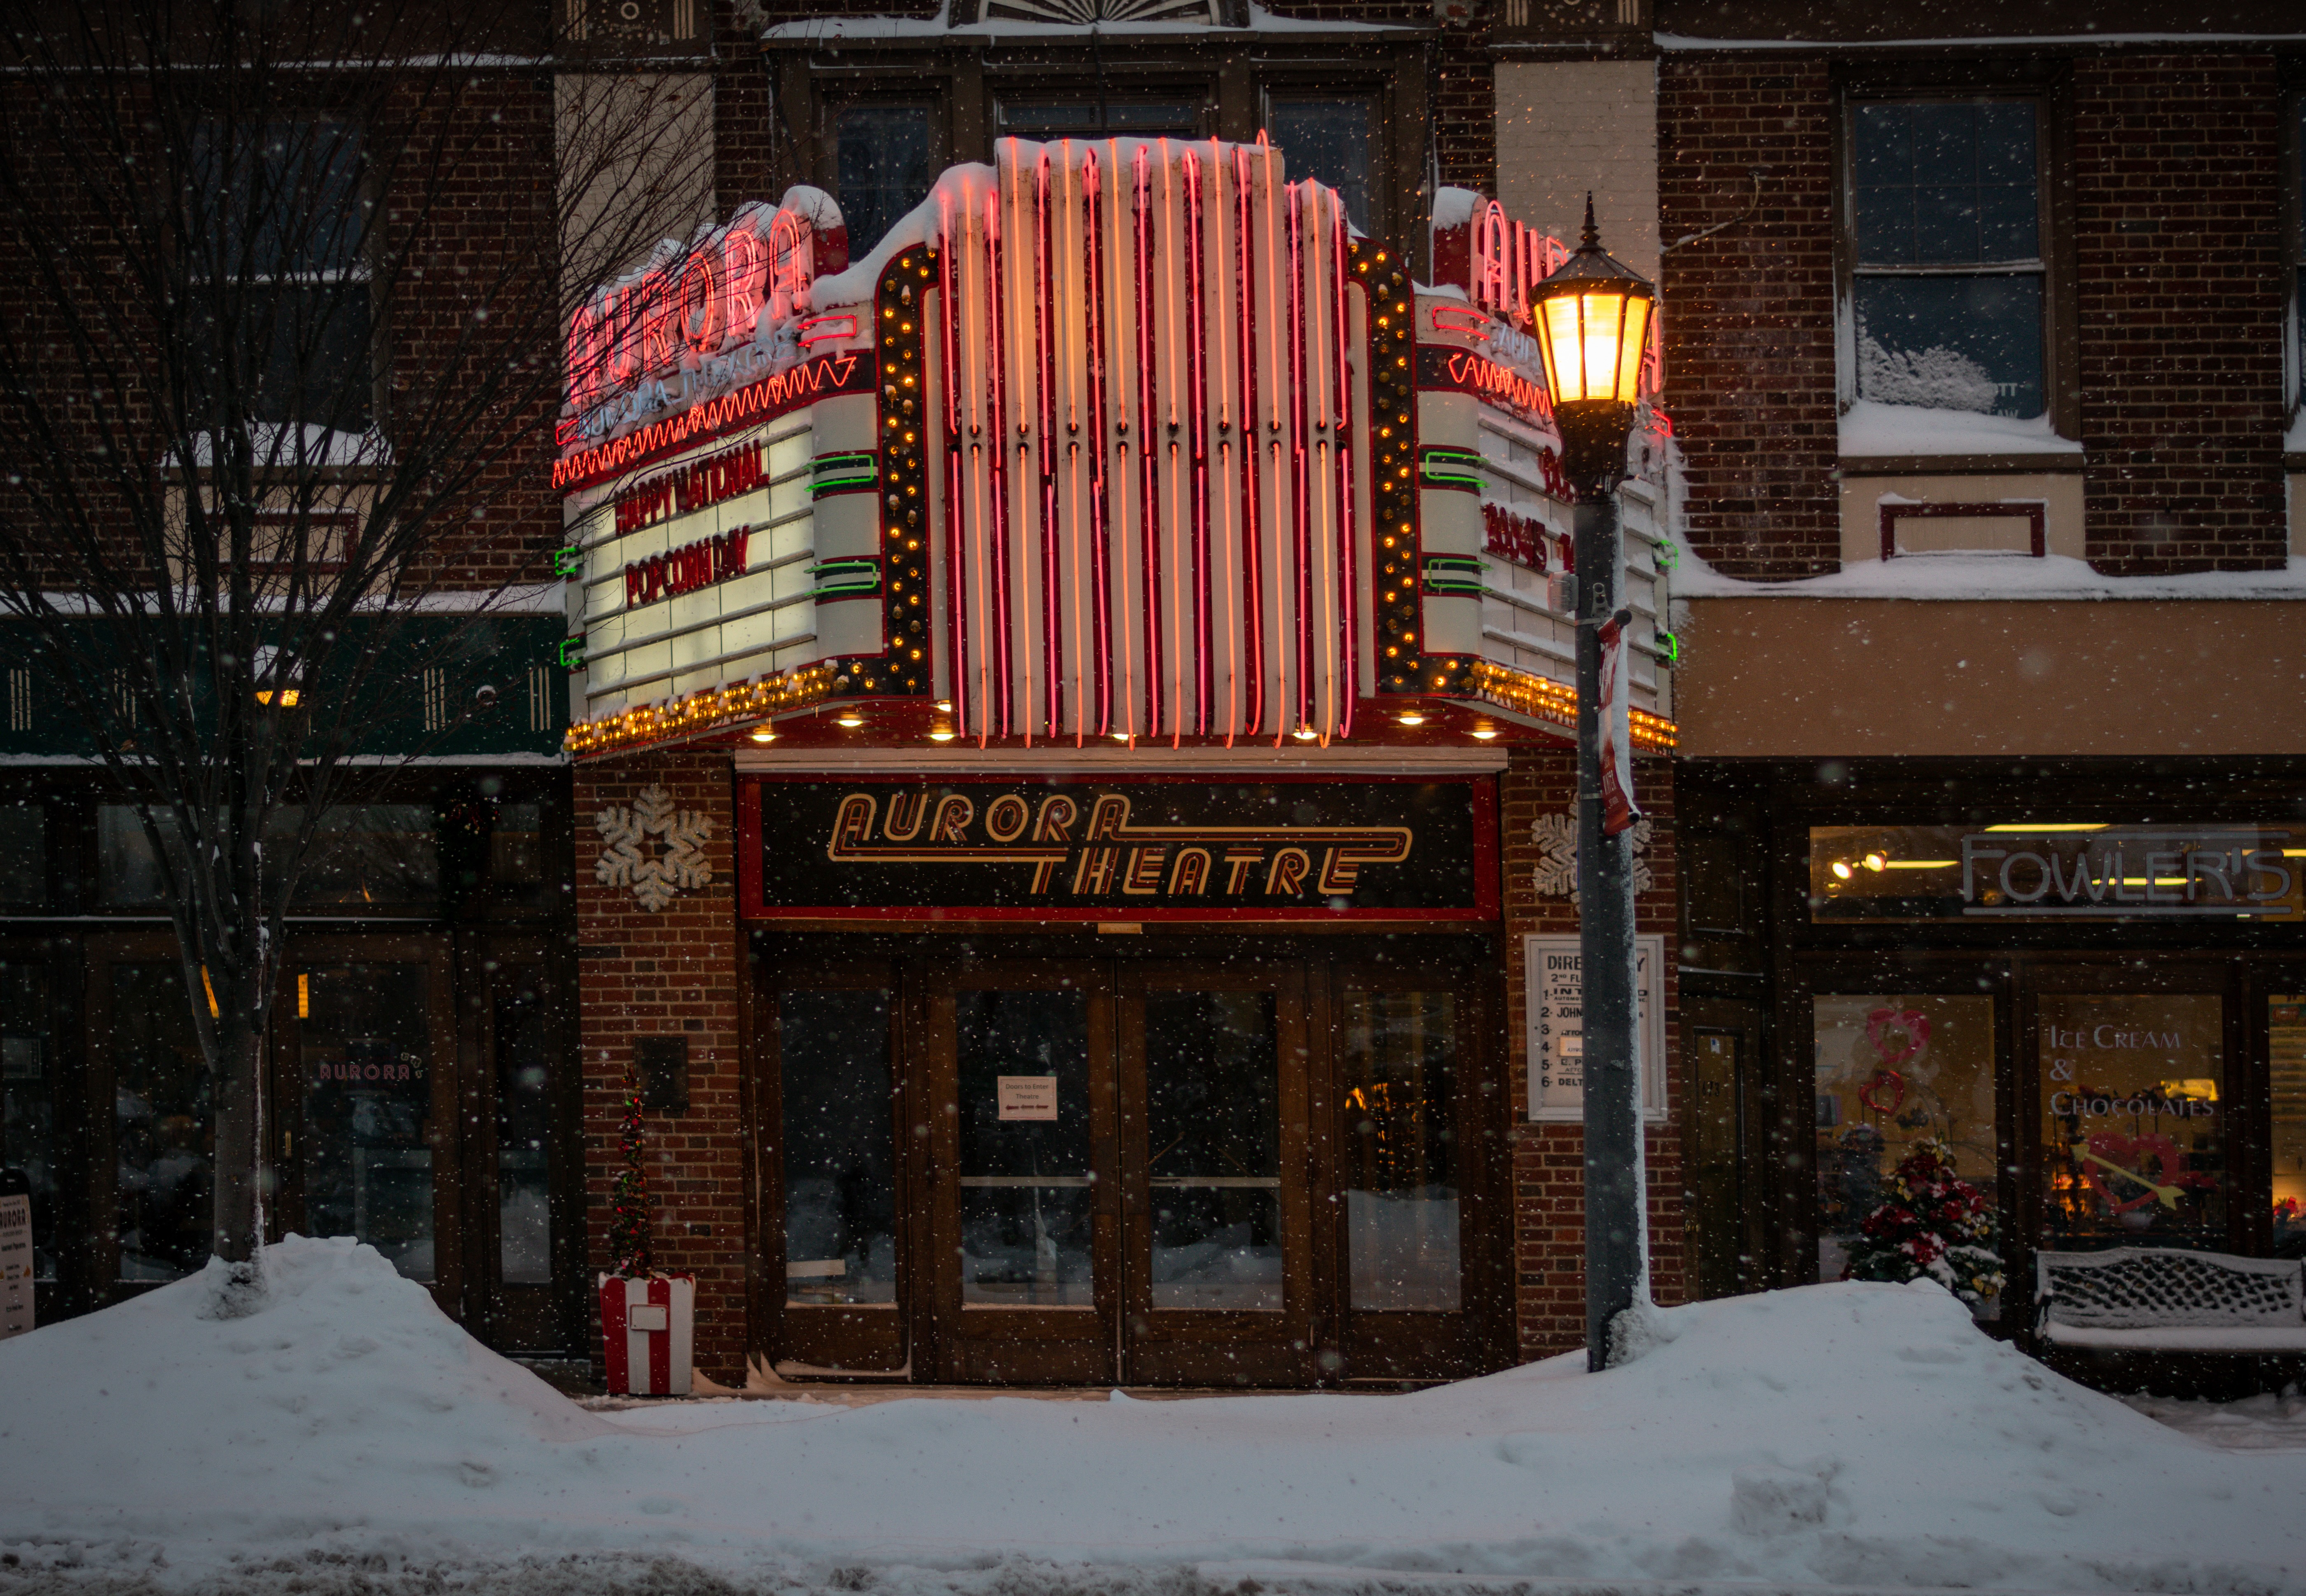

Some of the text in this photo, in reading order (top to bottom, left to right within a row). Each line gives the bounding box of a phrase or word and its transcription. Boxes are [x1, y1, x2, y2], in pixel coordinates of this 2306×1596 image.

[569, 208, 807, 405] AURORA
[614, 439, 769, 537] HAPPY NATIONAL
[625, 525, 750, 610] POPCORN DAY
[828, 793, 1133, 853] AURORA
[1024, 847, 1360, 895] THEATRE
[1962, 832, 2292, 903] FOWLER'S
[1548, 955, 1645, 972] DIREY
[2050, 1024, 2181, 1049] ICE CREAM
[320, 1064, 410, 1080] AURORA
[2049, 1058, 2072, 1081] &
[2050, 1091, 2215, 1116] CHOCOLATES
